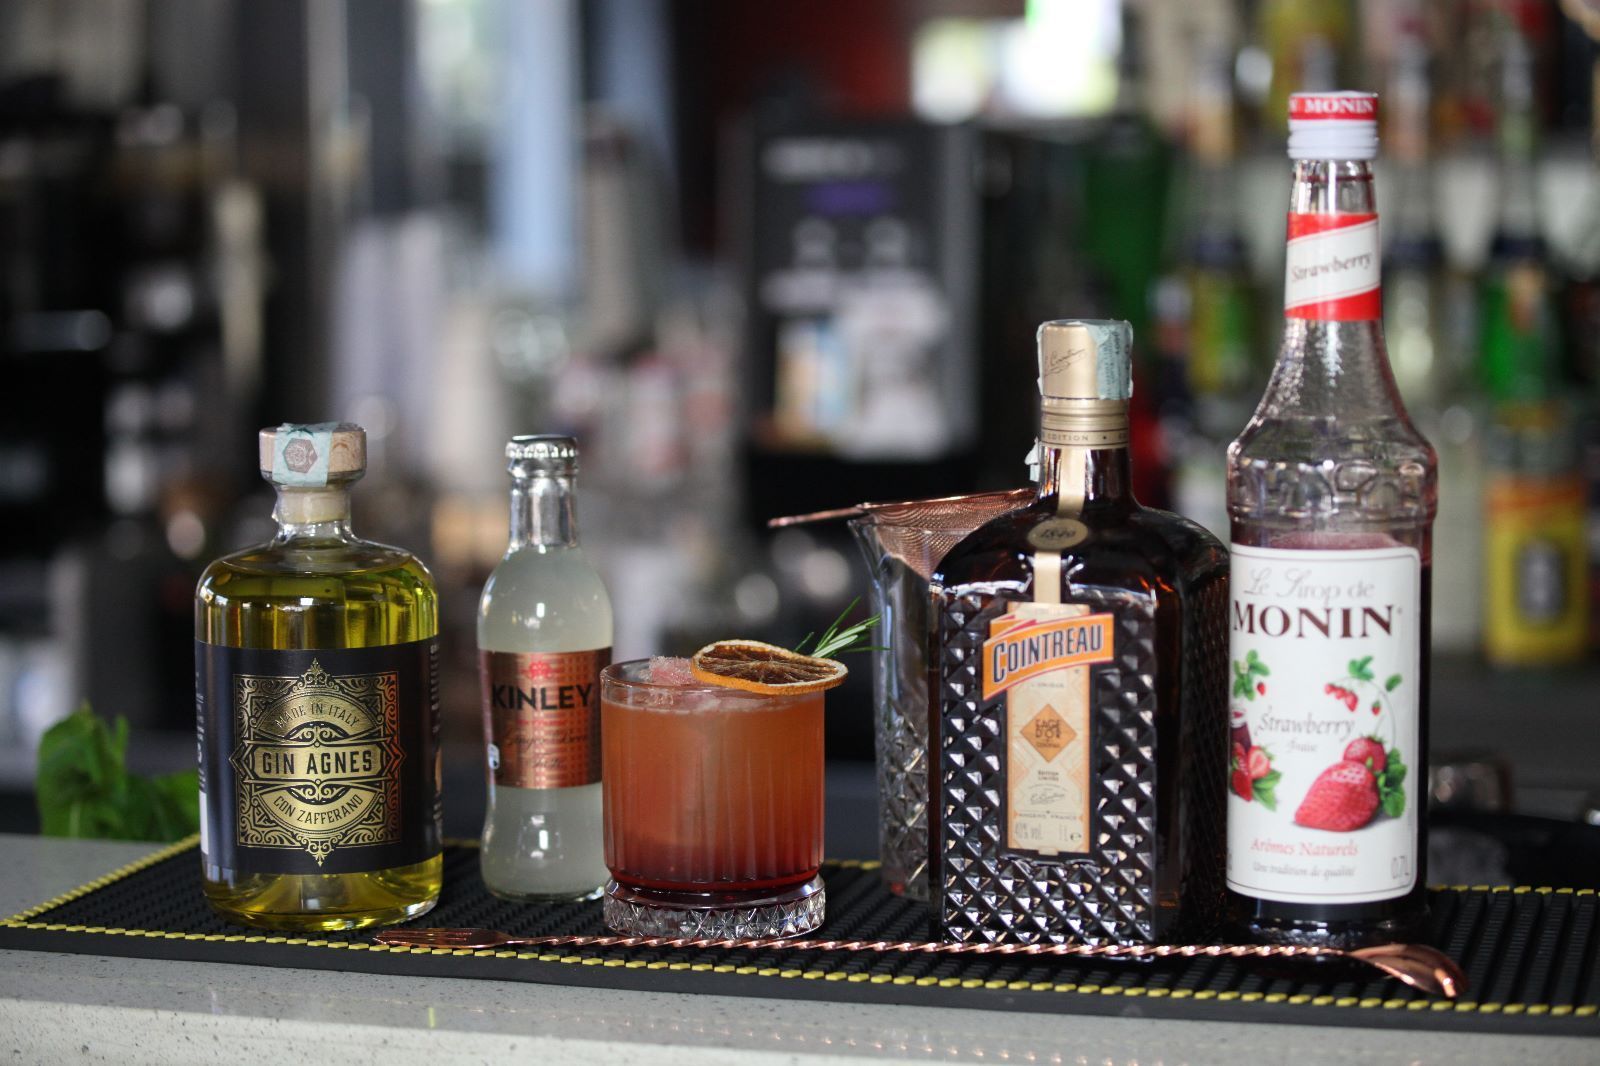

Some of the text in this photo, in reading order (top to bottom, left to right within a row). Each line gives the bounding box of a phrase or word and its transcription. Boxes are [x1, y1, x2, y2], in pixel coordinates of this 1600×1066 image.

[1304, 98, 1374, 114] MONIN
[1291, 251, 1373, 282] Strawberry
[1048, 432, 1089, 442] EDITION
[1243, 566, 1375, 606] Le Sirop de
[1232, 600, 1394, 639] MONIN
[992, 624, 1104, 684] COINTREAU
[491, 682, 594, 711] KINLEY
[274, 702, 361, 730] MADE IN ITALY
[1253, 704, 1356, 743] Strawberry
[261, 750, 373, 775] GIN AGNES
[272, 793, 364, 825] CON ZAFFERANO
[1299, 838, 1359, 857] Naturels
